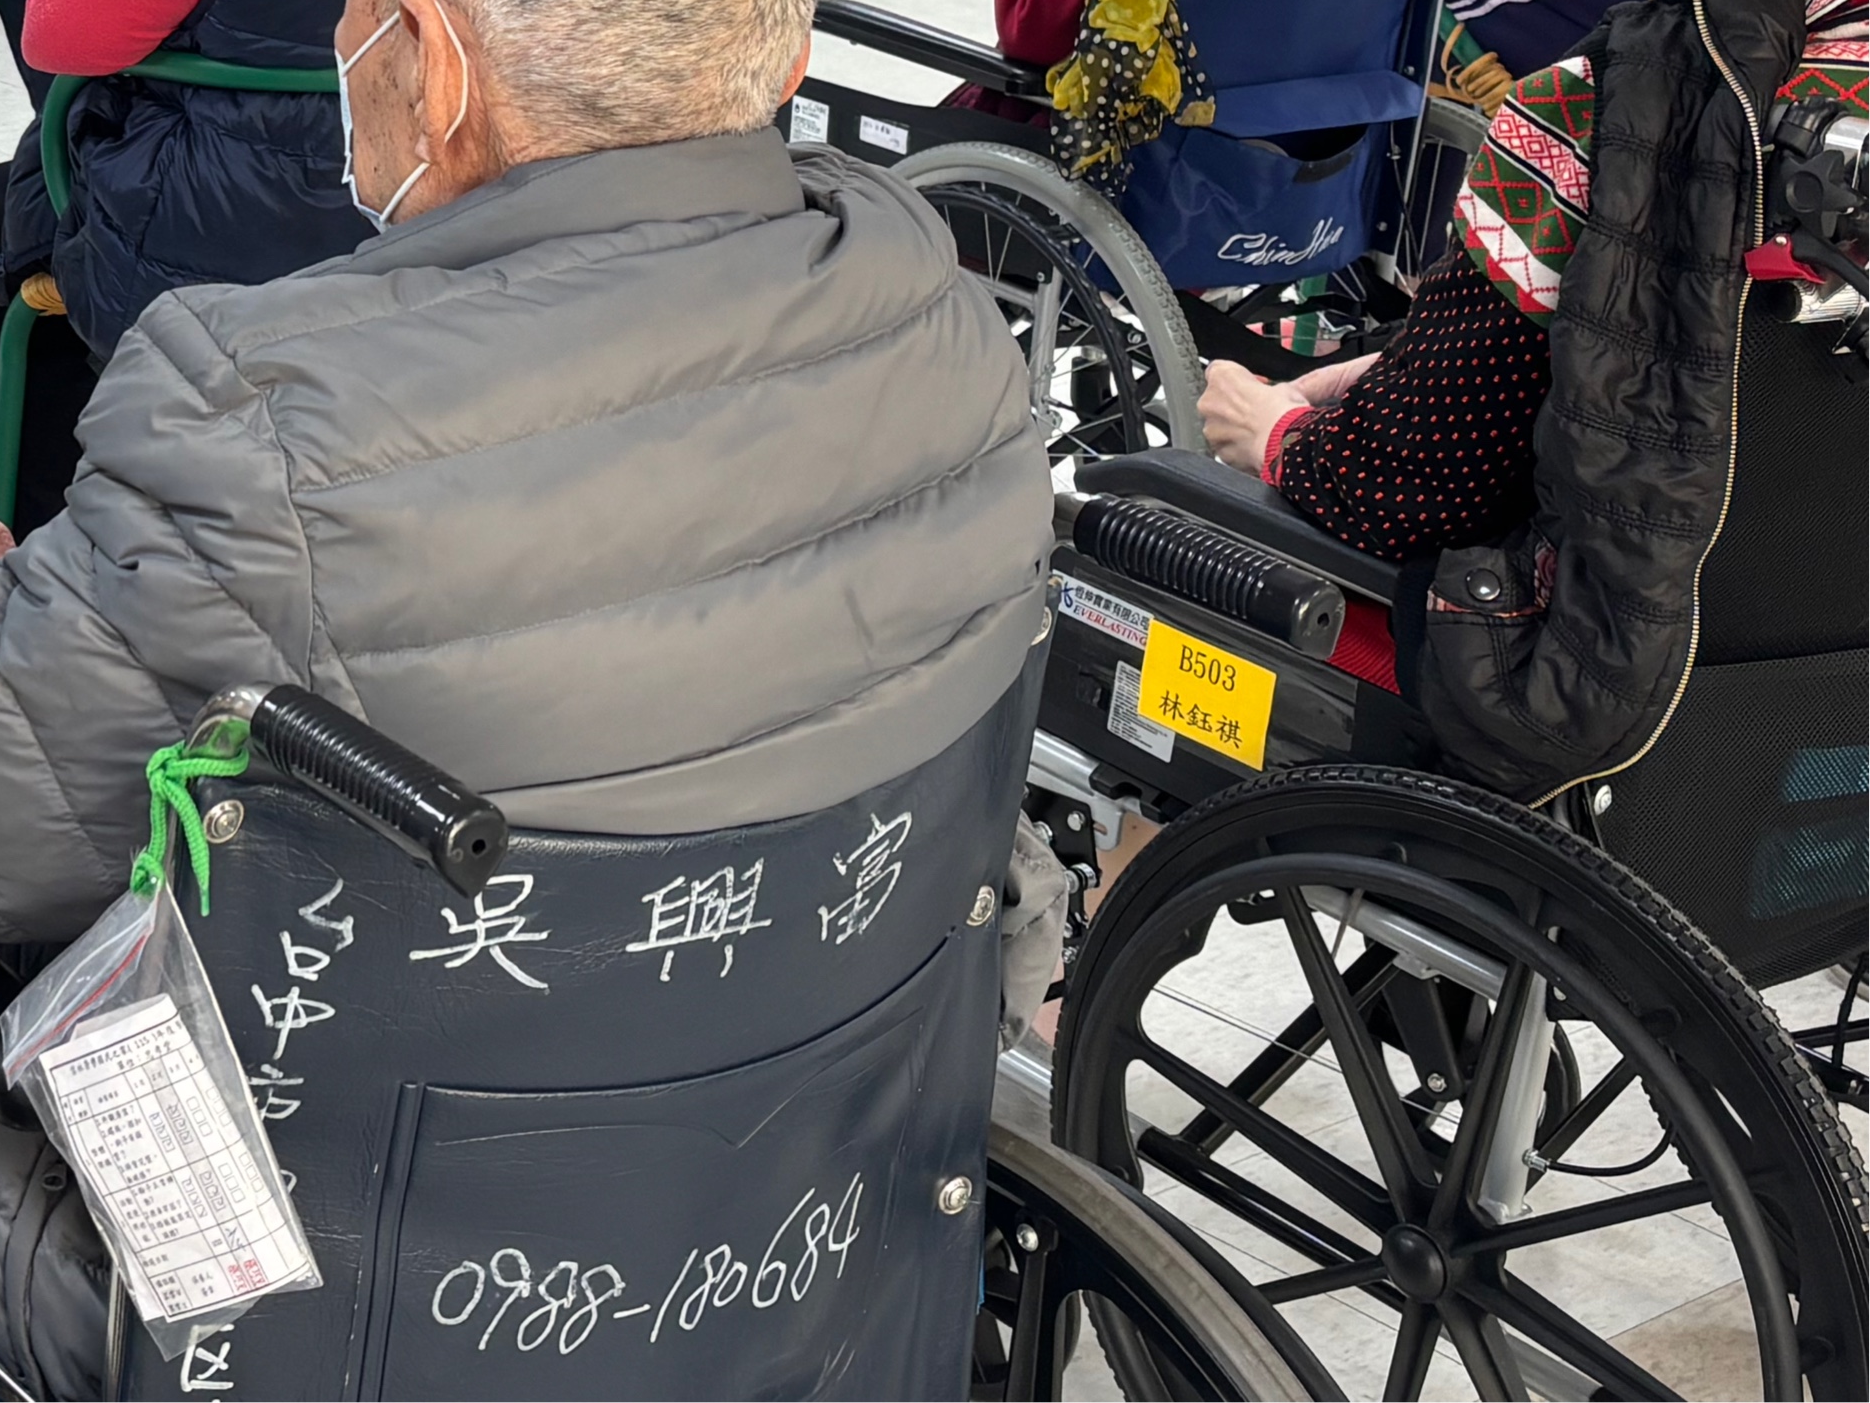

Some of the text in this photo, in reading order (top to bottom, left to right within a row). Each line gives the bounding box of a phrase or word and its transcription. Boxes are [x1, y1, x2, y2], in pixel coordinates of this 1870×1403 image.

[1073, 605, 1147, 647] EVERLASTING
[1179, 644, 1237, 692] B503
[1158, 689, 1244, 750] 林鈺祺
[432, 1173, 864, 1355] 0988-180684
